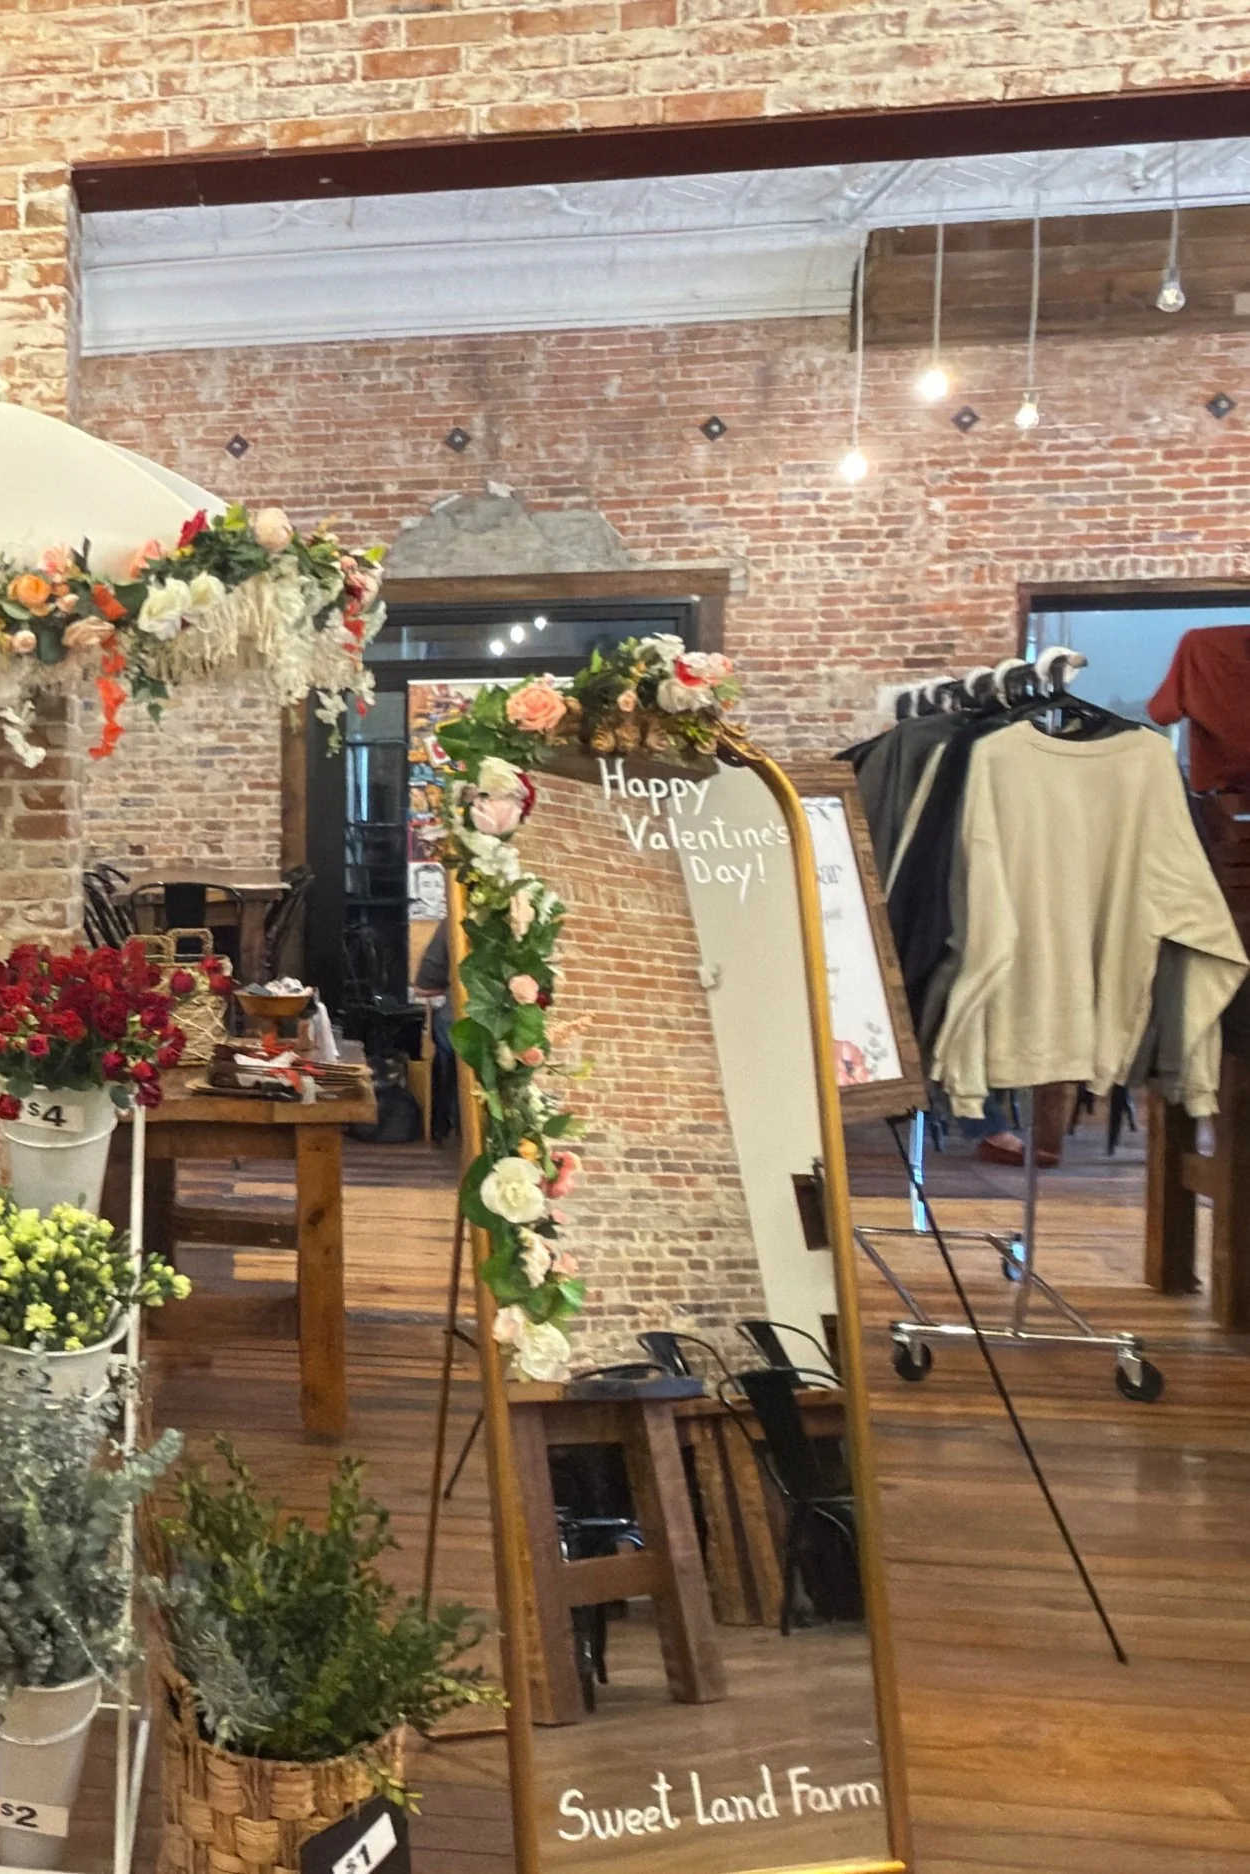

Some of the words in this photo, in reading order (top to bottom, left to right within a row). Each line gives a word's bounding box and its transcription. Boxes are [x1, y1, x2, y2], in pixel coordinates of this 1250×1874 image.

[597, 757, 710, 816] Happy
[621, 816, 791, 850] Valentine's
[689, 852, 766, 904] Day!
[27, 1102, 67, 1127] $4
[0, 1802, 39, 1828] $2
[557, 1770, 681, 1841] Sweet
[690, 1764, 781, 1826] Land
[786, 1765, 882, 1816] Farm
